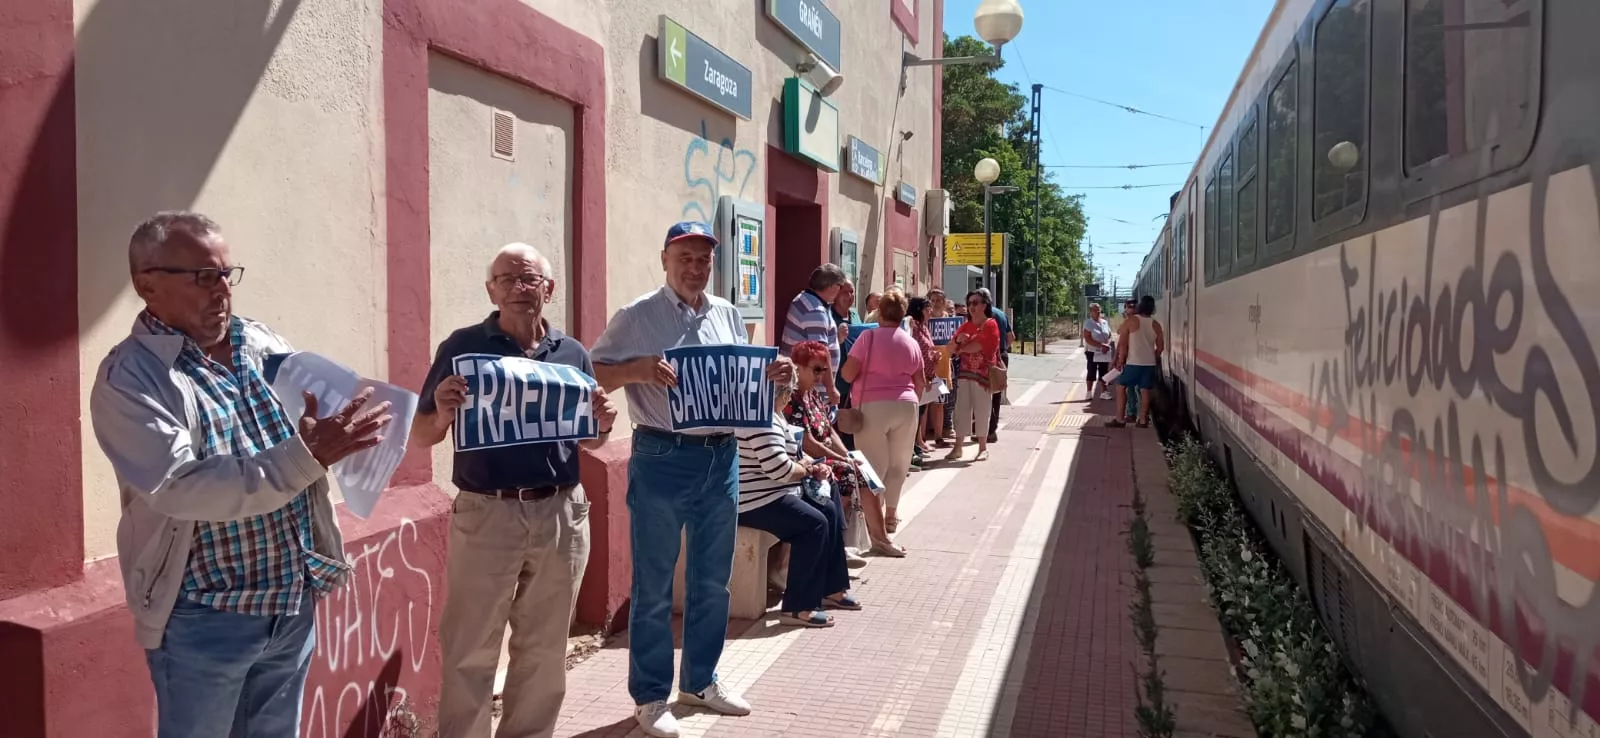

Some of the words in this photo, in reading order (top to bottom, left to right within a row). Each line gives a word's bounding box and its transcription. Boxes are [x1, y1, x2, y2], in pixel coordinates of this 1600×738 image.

[799, 0, 823, 40] GRAÑÉN
[703, 59, 738, 98] Zaragoza
[457, 359, 594, 447] FRAELLA
[670, 355, 773, 424] SANGARREN
